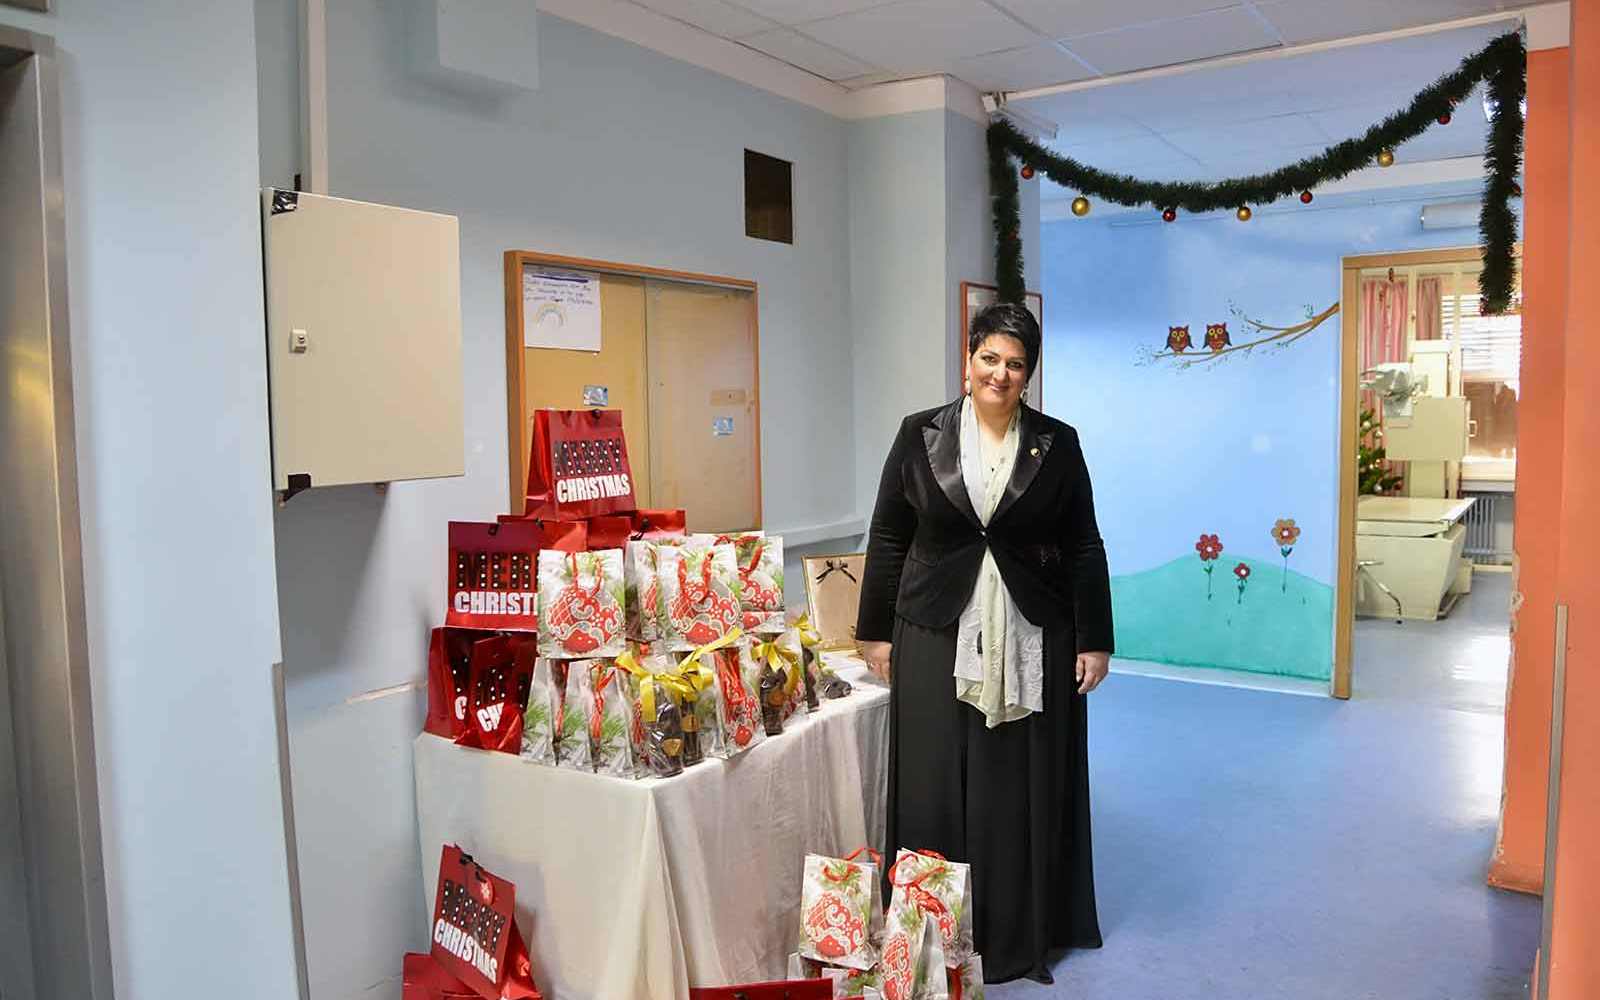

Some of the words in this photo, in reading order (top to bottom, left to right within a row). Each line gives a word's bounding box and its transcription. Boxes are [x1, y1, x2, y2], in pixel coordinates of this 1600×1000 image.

[554, 438, 622, 476] MERRY
[556, 473, 631, 503] CHRISTMAS
[456, 552, 539, 590] MER
[454, 590, 538, 616] CHRIST
[441, 879, 507, 952] MERRY
[434, 918, 498, 984] CHRISTMAS
